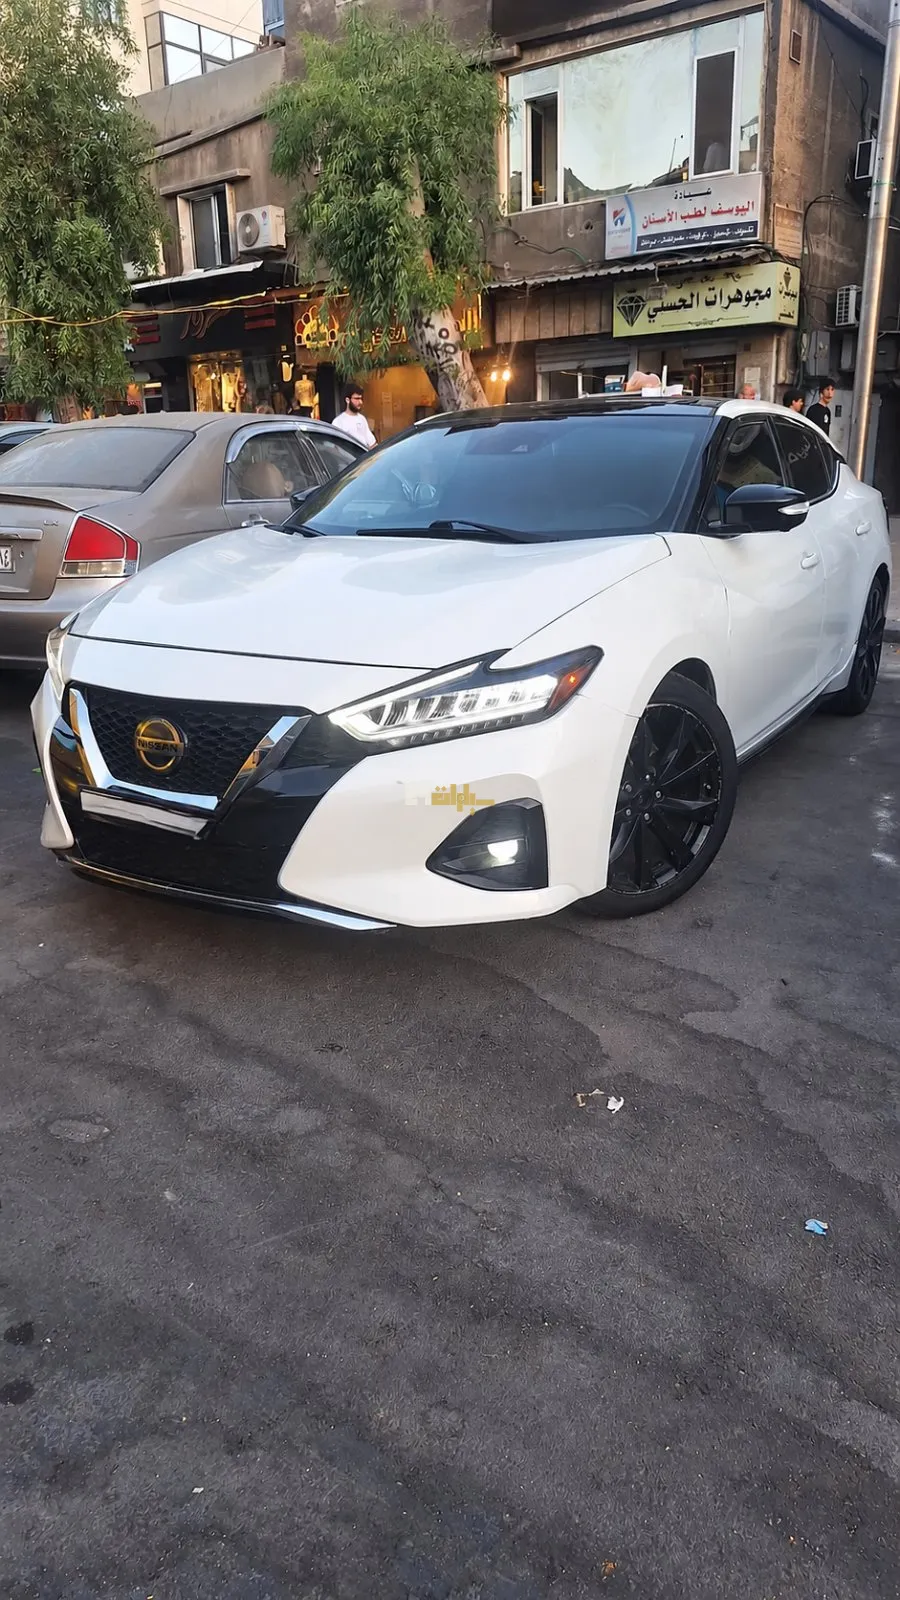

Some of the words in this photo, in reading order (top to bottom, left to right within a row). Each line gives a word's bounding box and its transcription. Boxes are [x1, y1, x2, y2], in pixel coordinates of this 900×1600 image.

[674, 187, 712, 200] عيادة
[680, 206, 707, 223] لطب
[711, 200, 755, 217] اليوسف
[641, 209, 678, 229] الأسنان
[704, 286, 772, 311] مجوهرات
[138, 740, 178, 753] NISSAN
